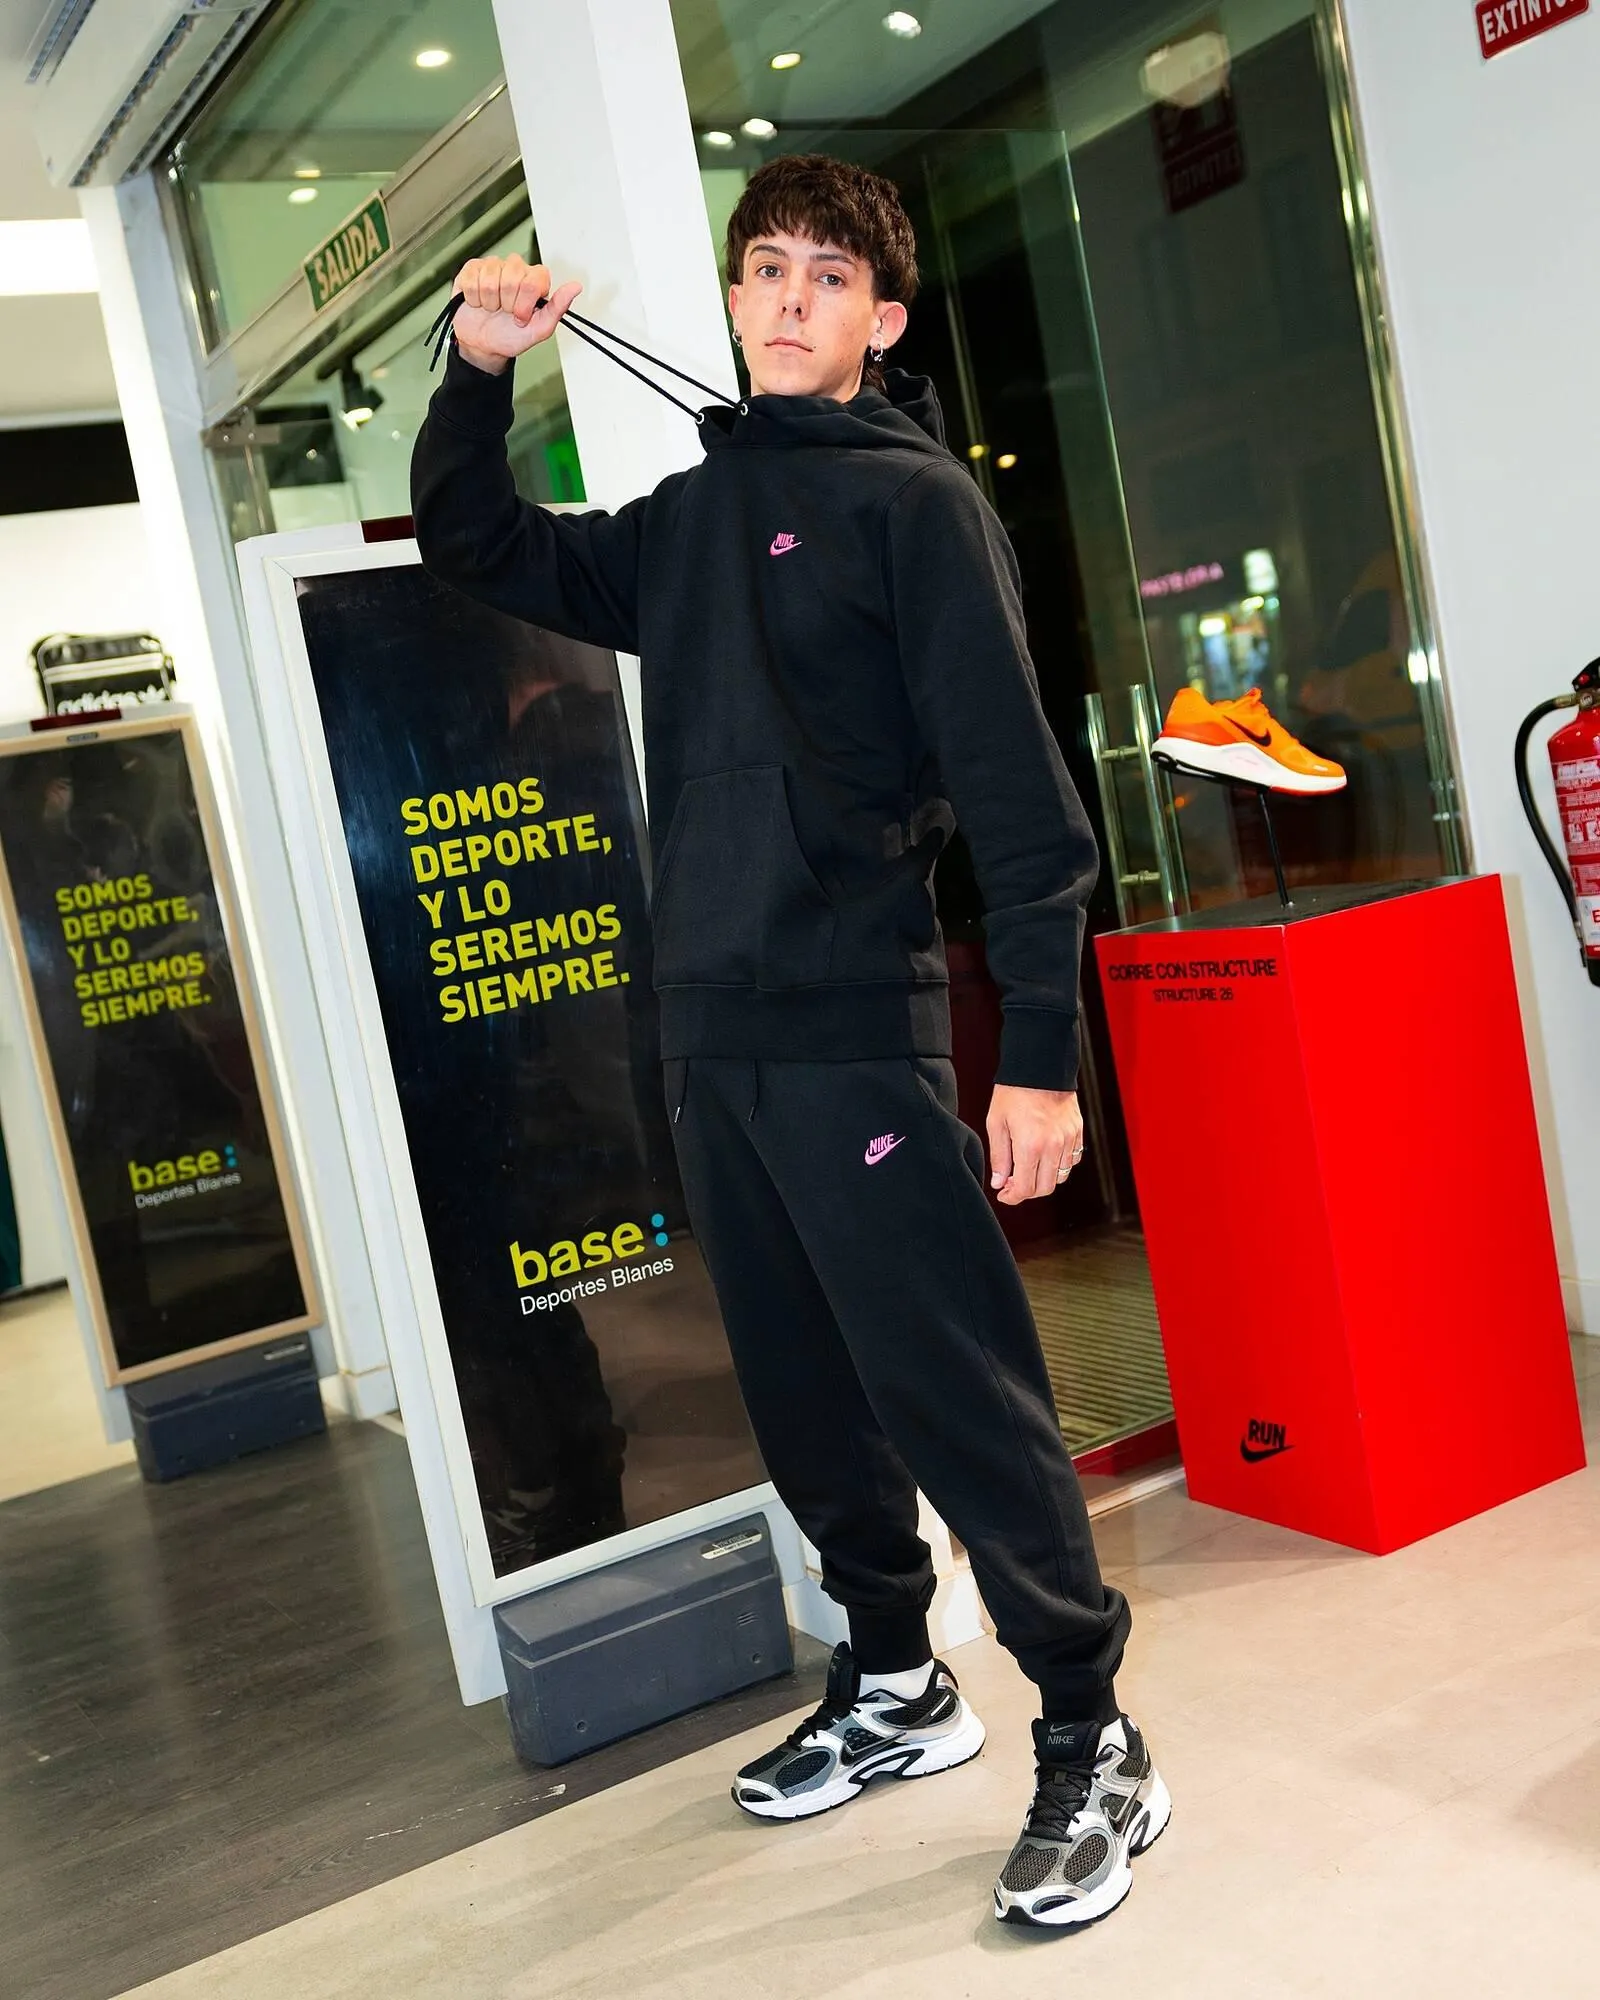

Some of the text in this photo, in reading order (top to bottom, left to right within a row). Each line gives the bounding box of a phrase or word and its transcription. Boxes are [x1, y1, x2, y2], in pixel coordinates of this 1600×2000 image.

[314, 212, 382, 301] SALIDA
[401, 777, 545, 836] SOMOS
[410, 813, 612, 883] DEPORTE,
[55, 873, 153, 913] SOMOS
[417, 879, 512, 929] Y LO
[61, 896, 199, 942] DEPORTE,
[429, 904, 622, 977] SEREMOS
[66, 936, 131, 970] Y LO
[74, 952, 206, 999] SEREMOS
[1108, 958, 1278, 982] CORRE CON STRUCTURE
[81, 980, 212, 1028] SIEMPRE.
[439, 950, 631, 1023] SIEMPRE.
[1153, 987, 1217, 1003] STRUCTURE
[869, 1133, 895, 1155] NIKE
[520, 1257, 674, 1316] Deportes Blanes
[1248, 1418, 1287, 1449] RUN
[1047, 1735, 1076, 1745] NIKE
